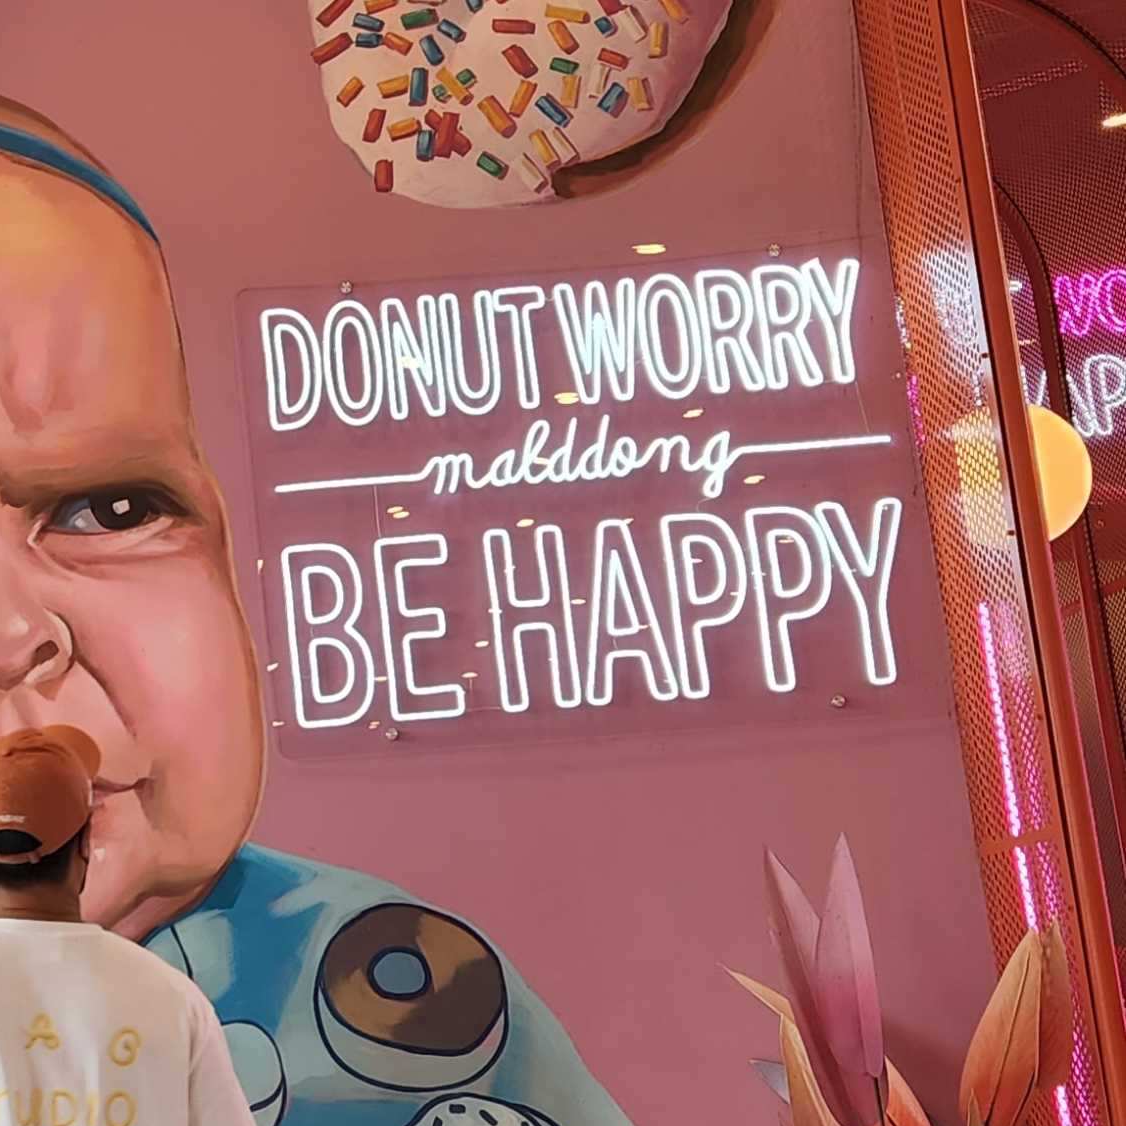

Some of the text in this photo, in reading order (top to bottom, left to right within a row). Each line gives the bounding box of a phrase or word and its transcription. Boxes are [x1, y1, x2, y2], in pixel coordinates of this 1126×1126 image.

[260, 285, 546, 432] DONUT
[552, 257, 861, 406] WORRY
[424, 413, 738, 499] malddong
[280, 496, 904, 730] BE HAPPY
